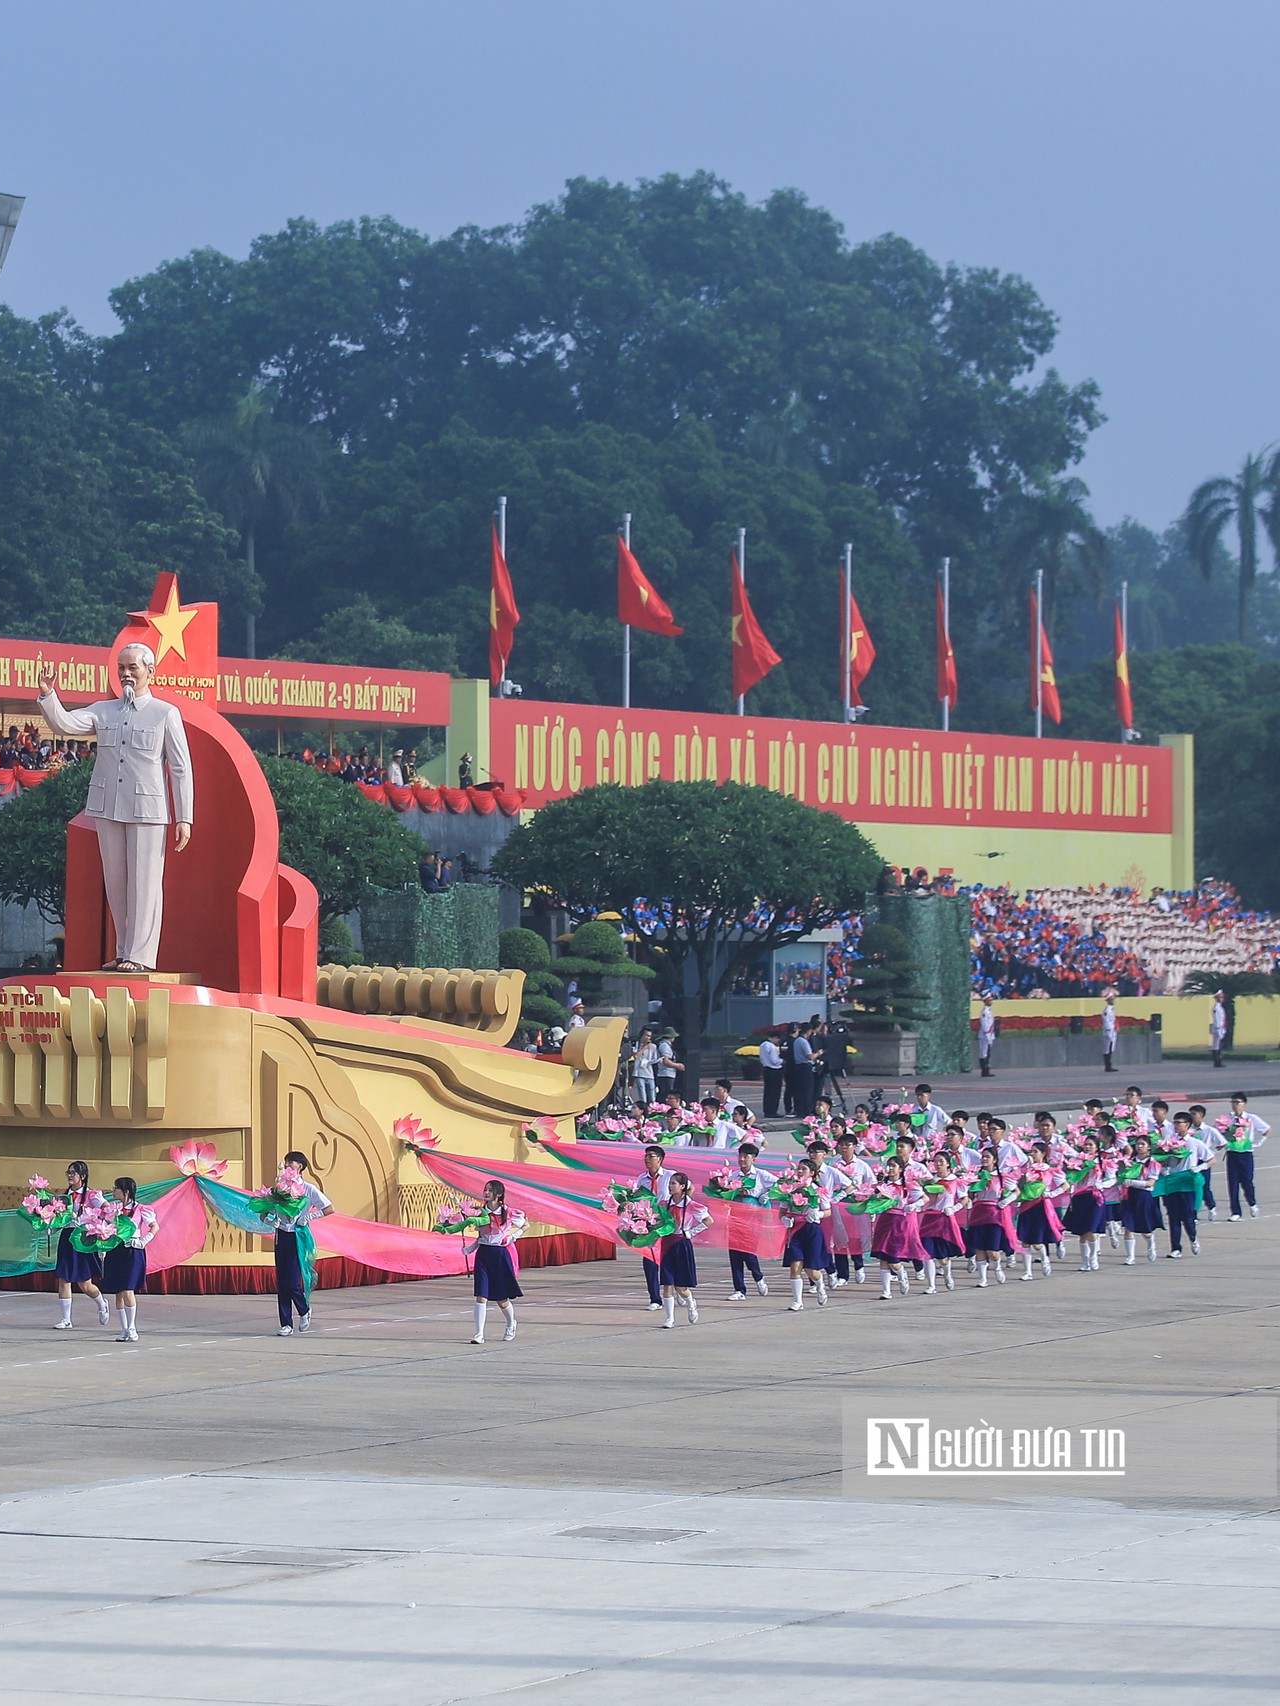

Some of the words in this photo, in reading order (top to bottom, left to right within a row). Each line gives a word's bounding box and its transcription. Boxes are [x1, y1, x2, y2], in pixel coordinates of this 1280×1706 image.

[58, 657, 96, 693] CÁCH
[156, 674, 168, 687] CÓ
[168, 674, 177, 687] GÌ
[177, 675, 196, 688] QUÝ
[196, 677, 215, 688] HƠN
[224, 670, 242, 703] VÀ
[245, 669, 278, 706] QUỐC
[281, 674, 325, 708] KHÁNH
[328, 681, 352, 710] 2-9
[354, 677, 379, 711] BẤT
[382, 681, 417, 717] DIỆT!
[515, 715, 583, 793] NƯỚC
[673, 725, 718, 783] HÒA
[730, 729, 757, 787] XÃ
[817, 731, 860, 806] CHỦ
[870, 740, 933, 808] NGHĨA
[942, 743, 985, 821] VIỆT
[993, 755, 1034, 812] NAM
[1042, 750, 1093, 816] MUÔN
[1102, 753, 1149, 818] NĂM!
[11, 992, 44, 1009] TỊCH
[19, 1010, 61, 1028] MINH
